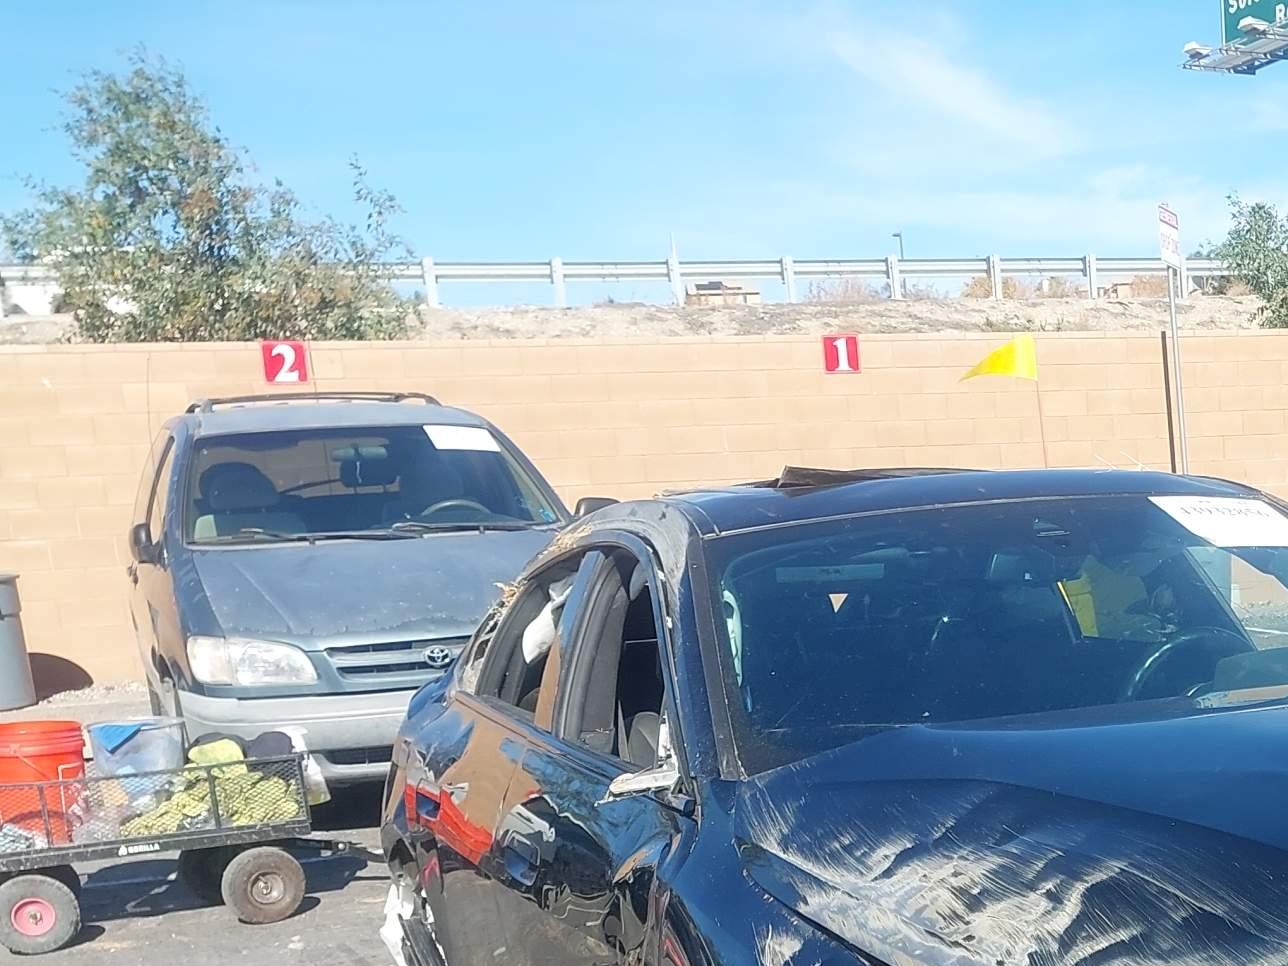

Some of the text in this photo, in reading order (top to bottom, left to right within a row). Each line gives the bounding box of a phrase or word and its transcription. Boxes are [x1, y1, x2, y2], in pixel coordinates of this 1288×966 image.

[271, 343, 299, 382] 2
[832, 337, 853, 371] 1
[127, 842, 160, 854] GORILLA
